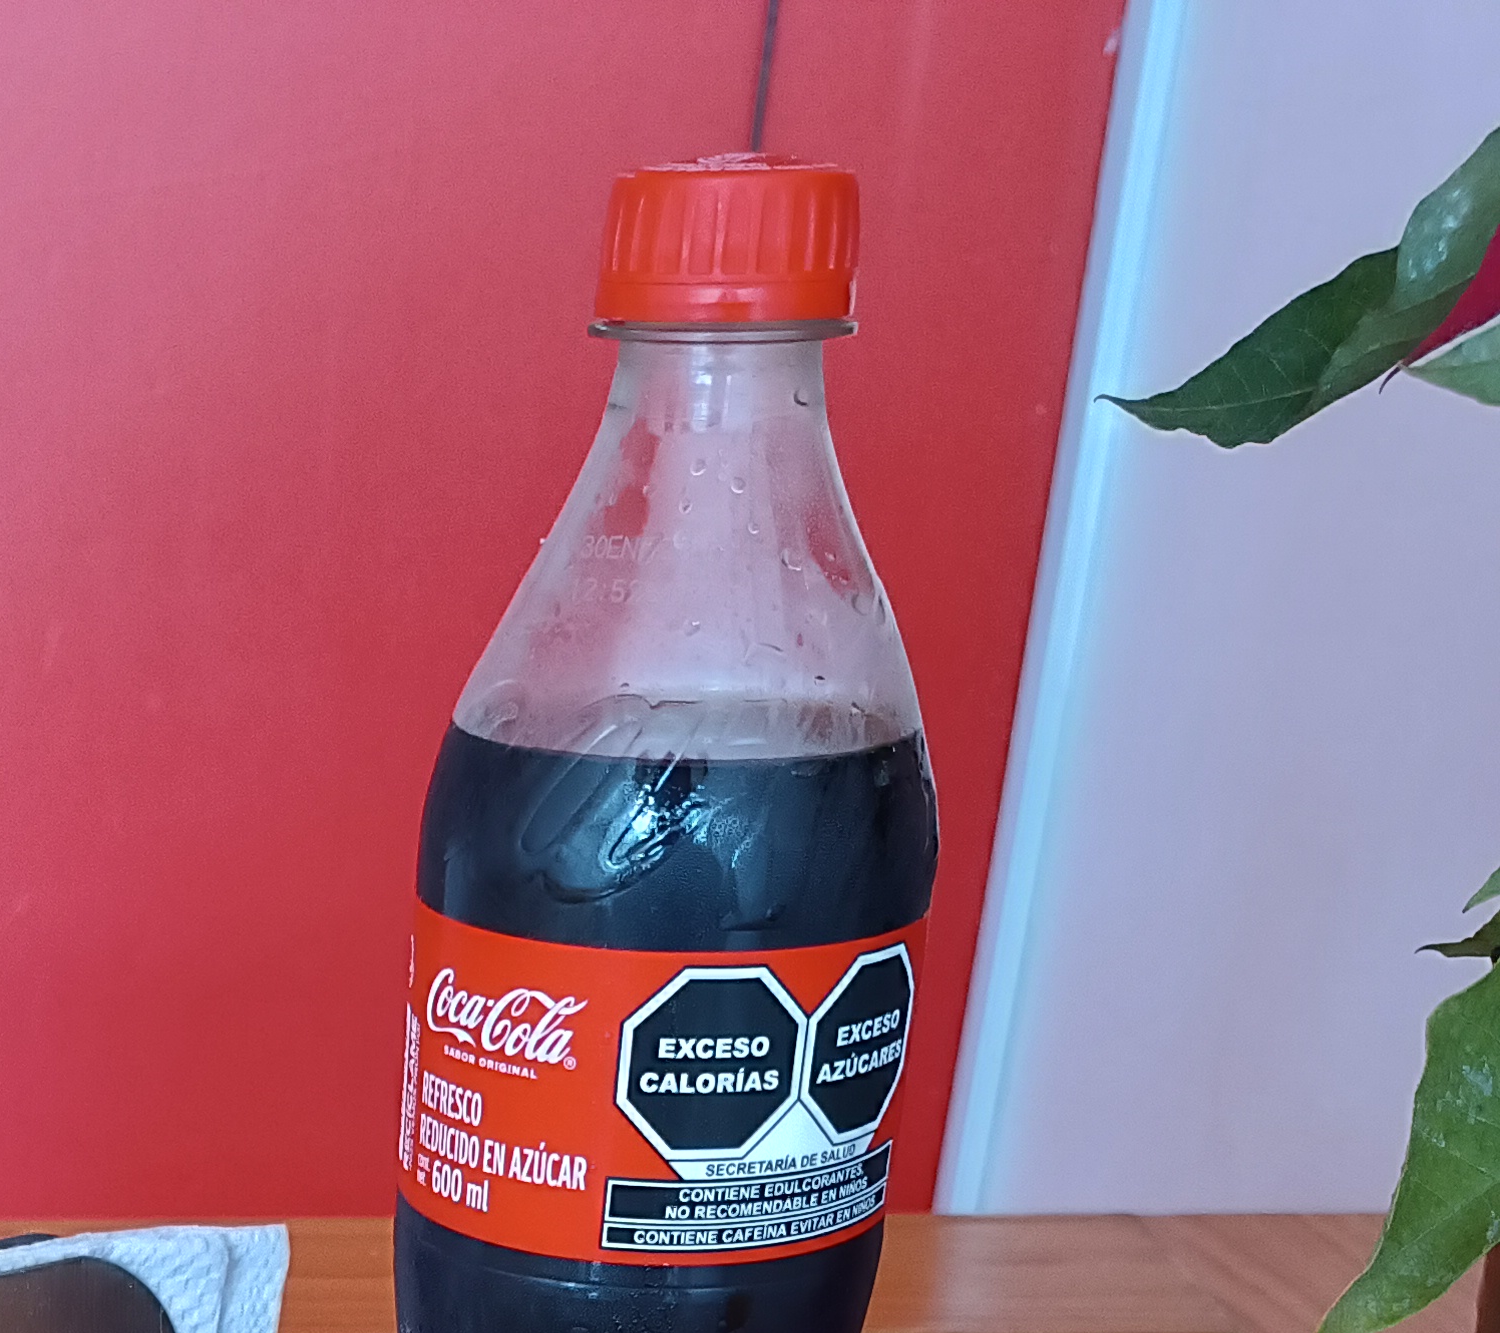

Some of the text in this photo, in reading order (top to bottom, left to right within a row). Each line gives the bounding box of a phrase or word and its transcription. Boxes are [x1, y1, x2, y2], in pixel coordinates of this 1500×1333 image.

[427, 967, 588, 1064] Coca-Cola
[836, 1009, 901, 1047] EXCESO
[443, 1045, 538, 1080] SABOR ORIGINAL
[657, 1036, 770, 1060] EXCESO
[815, 1038, 902, 1085] AZÚCARES
[421, 1070, 483, 1127] REFRESCO
[638, 1067, 780, 1094] CALORÍAS
[419, 1113, 588, 1191] REDUCIDO EN AZÚCAR
[705, 1143, 856, 1178] SECRETARÍA DE SALUD
[431, 1159, 490, 1213] 600 ml
[665, 1177, 868, 1220] NO RECOMENDABLE EN NIÑOS
[678, 1185, 760, 1203] CONTIENE
[633, 1227, 718, 1245] CONTIENE
[722, 1223, 787, 1243] CAFEÍNA
[790, 1215, 833, 1236] EVITAR
[836, 1209, 851, 1223] EN
